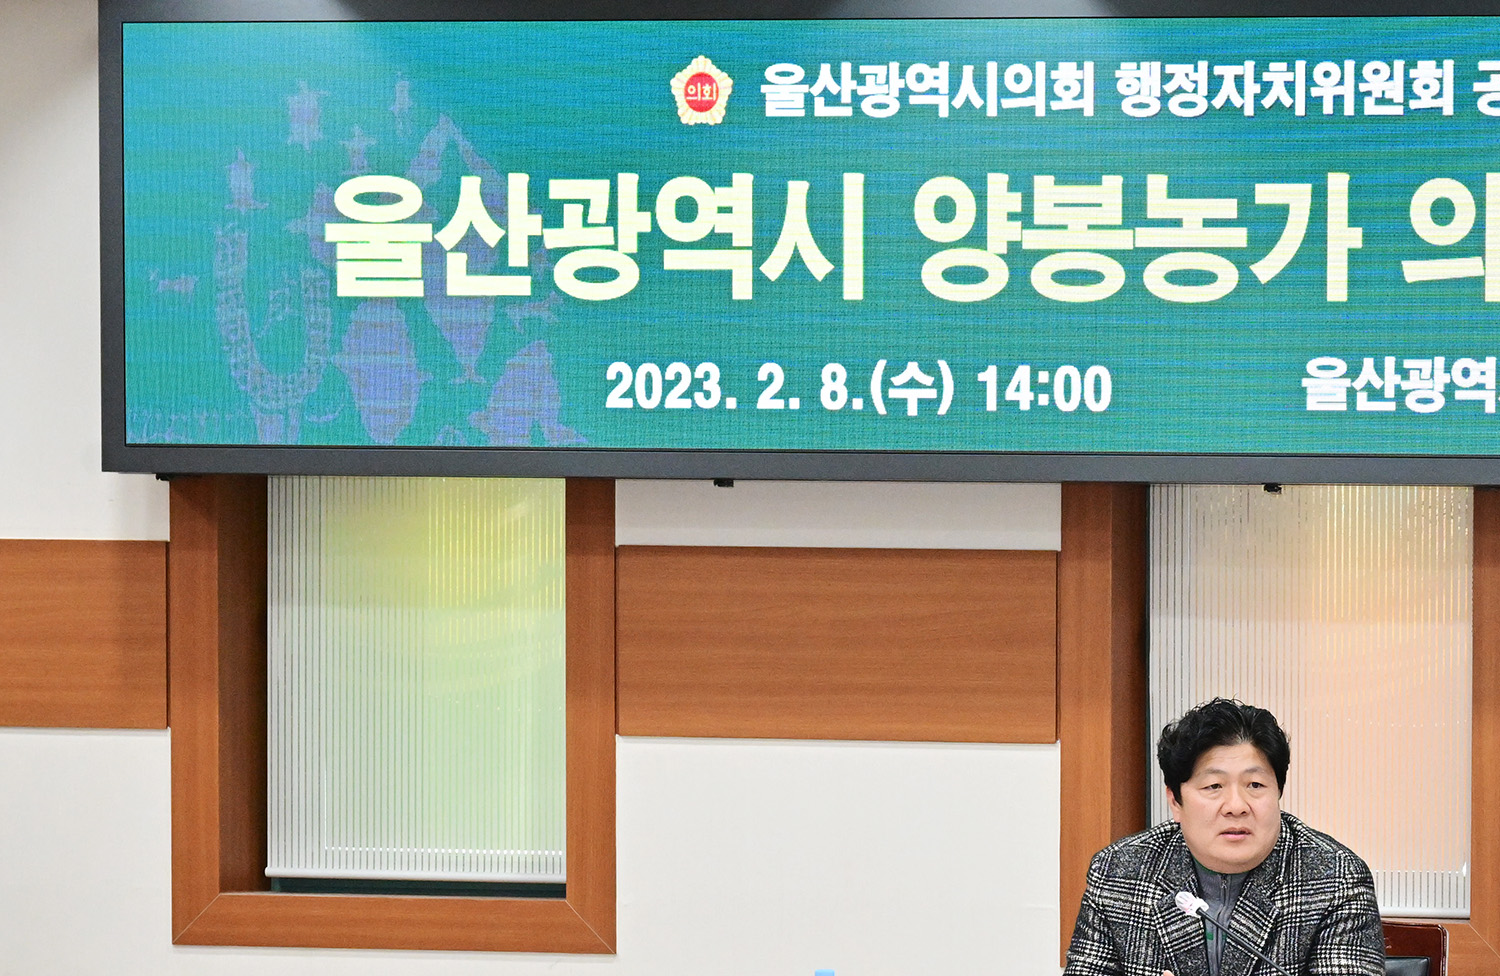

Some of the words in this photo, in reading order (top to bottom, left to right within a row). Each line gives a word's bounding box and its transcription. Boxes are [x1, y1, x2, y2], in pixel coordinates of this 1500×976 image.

[686, 82, 717, 101] 의회
[760, 61, 1095, 118] 울산광역시의회
[1114, 60, 1455, 118] 행정자치위원회
[324, 172, 865, 301] 울산광역시
[914, 172, 1363, 303] 양봉농가
[605, 361, 737, 412] 2023.
[756, 362, 800, 411] 2.
[977, 365, 1112, 412] 14:00
